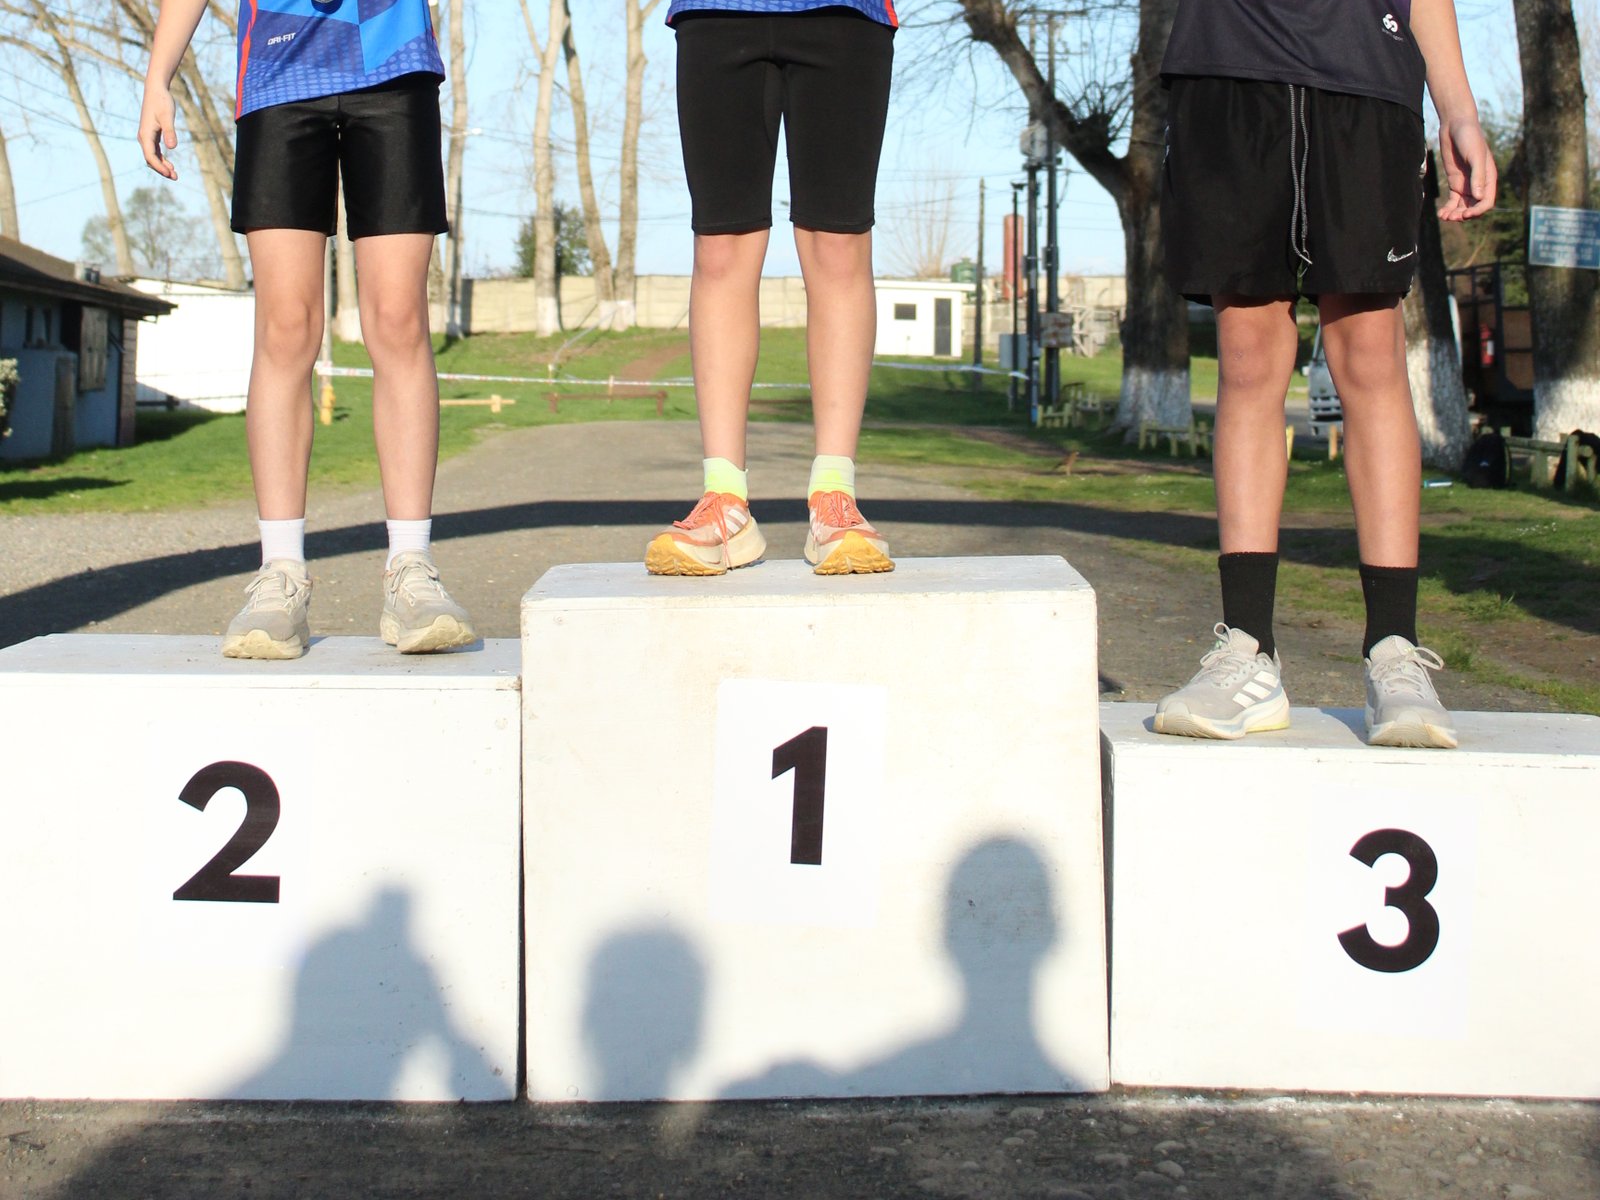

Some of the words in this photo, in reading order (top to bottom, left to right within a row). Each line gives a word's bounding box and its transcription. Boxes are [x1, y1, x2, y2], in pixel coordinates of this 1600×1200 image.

[173, 761, 280, 904] 2
[772, 726, 828, 866] 1
[1337, 829, 1440, 973] 3
